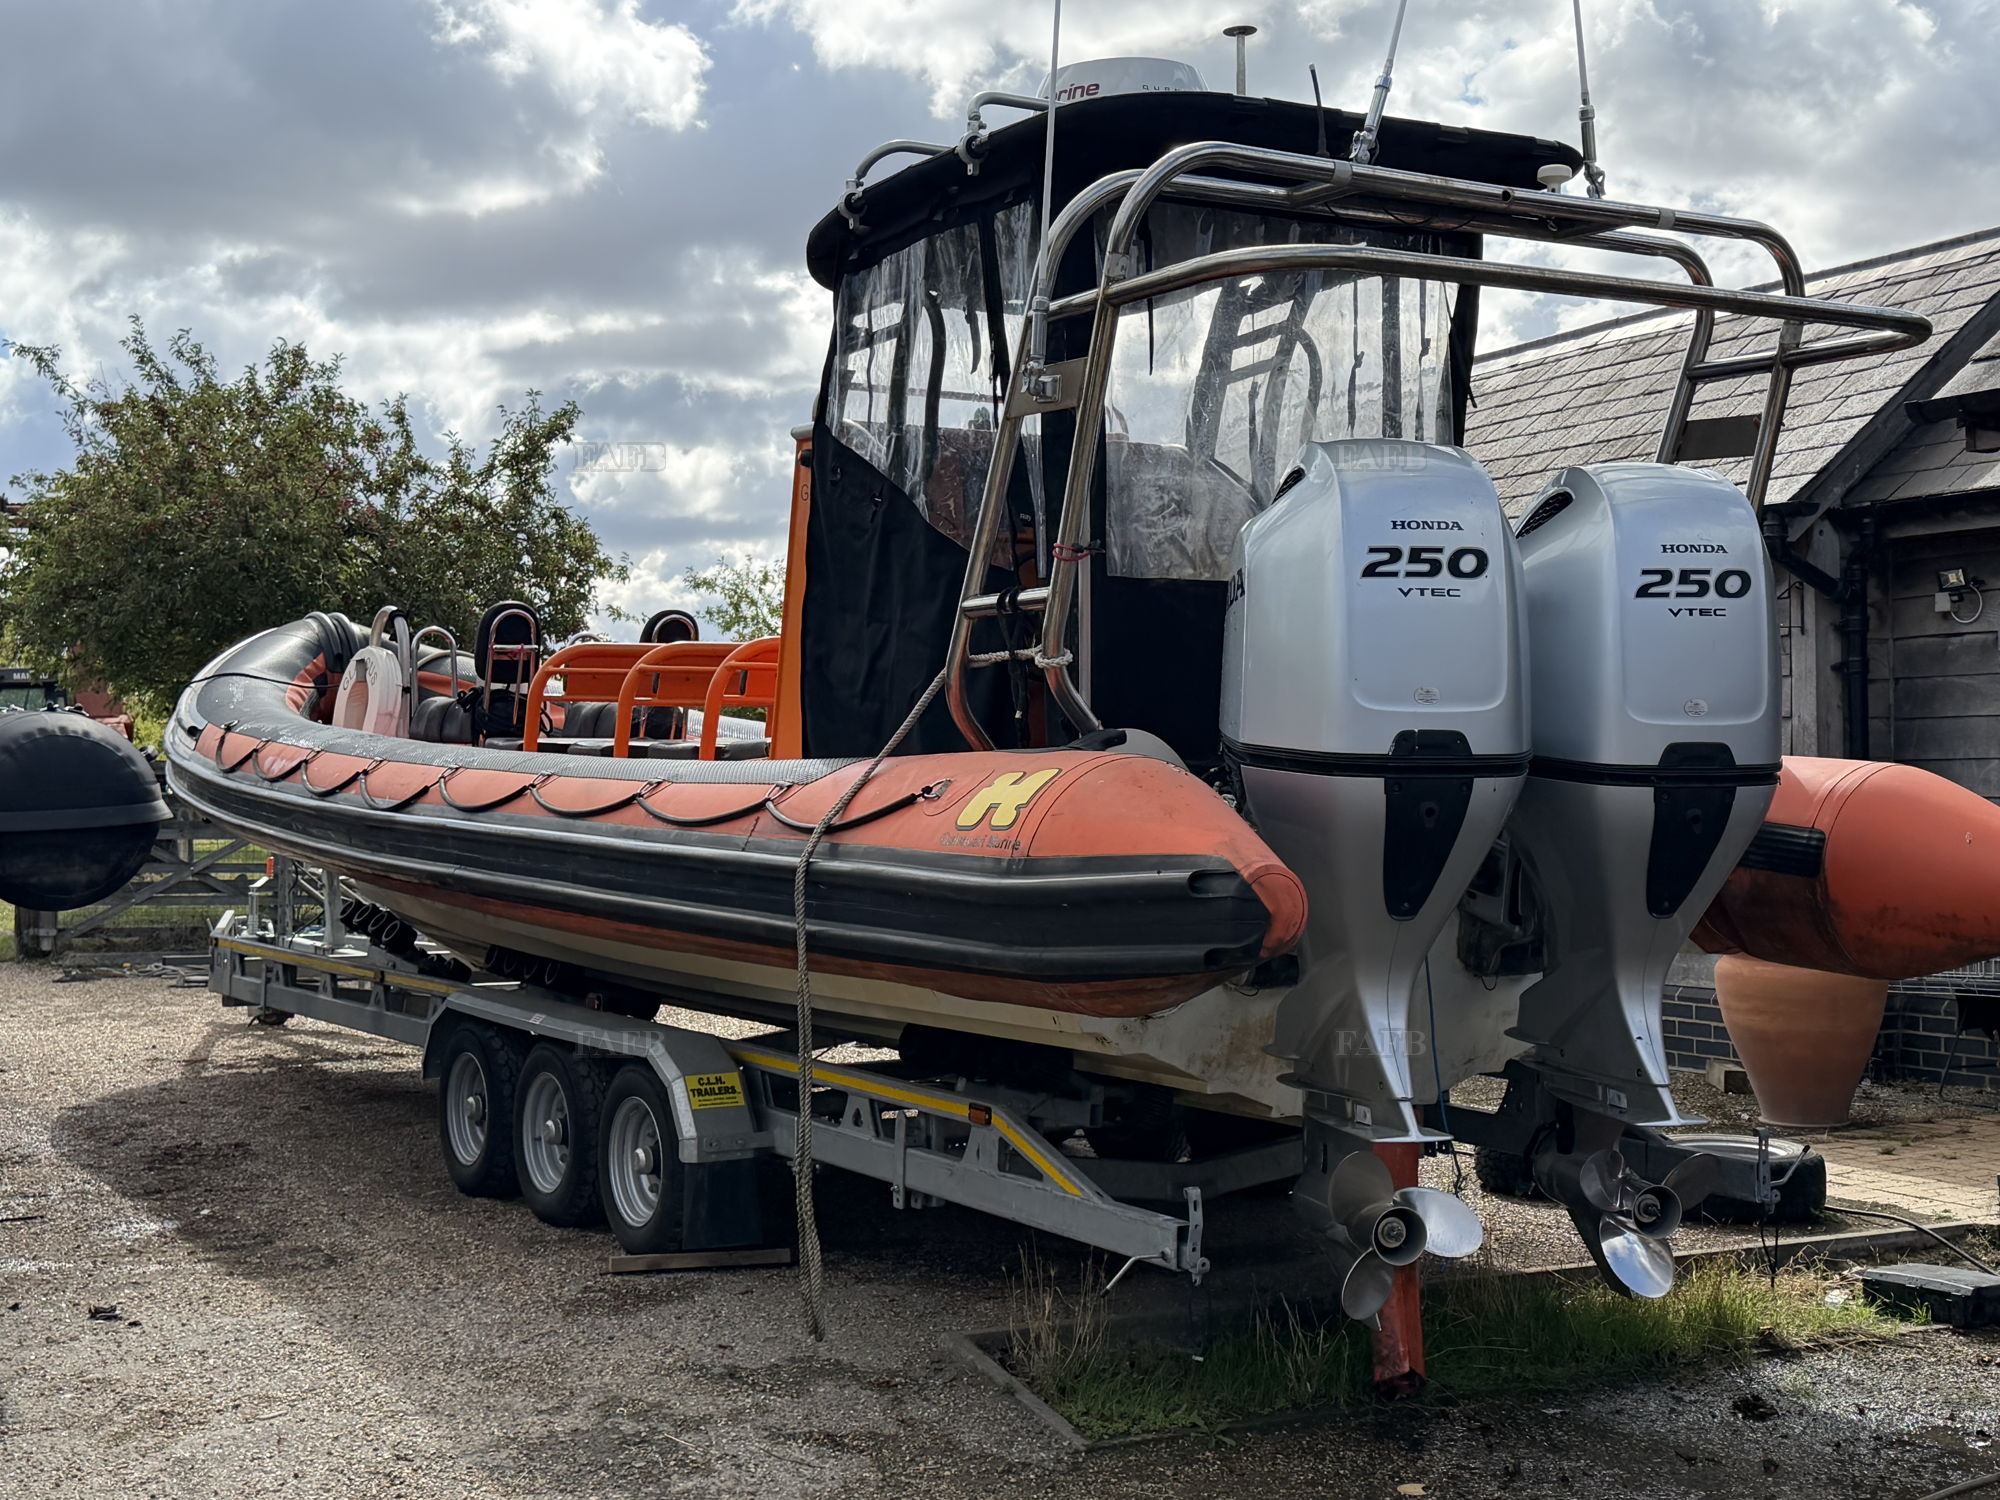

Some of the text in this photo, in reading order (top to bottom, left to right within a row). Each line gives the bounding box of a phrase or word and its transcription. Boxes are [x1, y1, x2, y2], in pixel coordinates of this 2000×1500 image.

[1390, 520, 1465, 531] HONDA
[1660, 544, 1729, 554] HONDA
[1360, 545, 1489, 580] 250
[1634, 568, 1752, 599] 250
[1397, 587, 1461, 598] VTEC
[1668, 607, 1727, 618] VTEC
[697, 1075, 726, 1086] C.L.H.
[689, 1085, 737, 1098] TRAILERS
